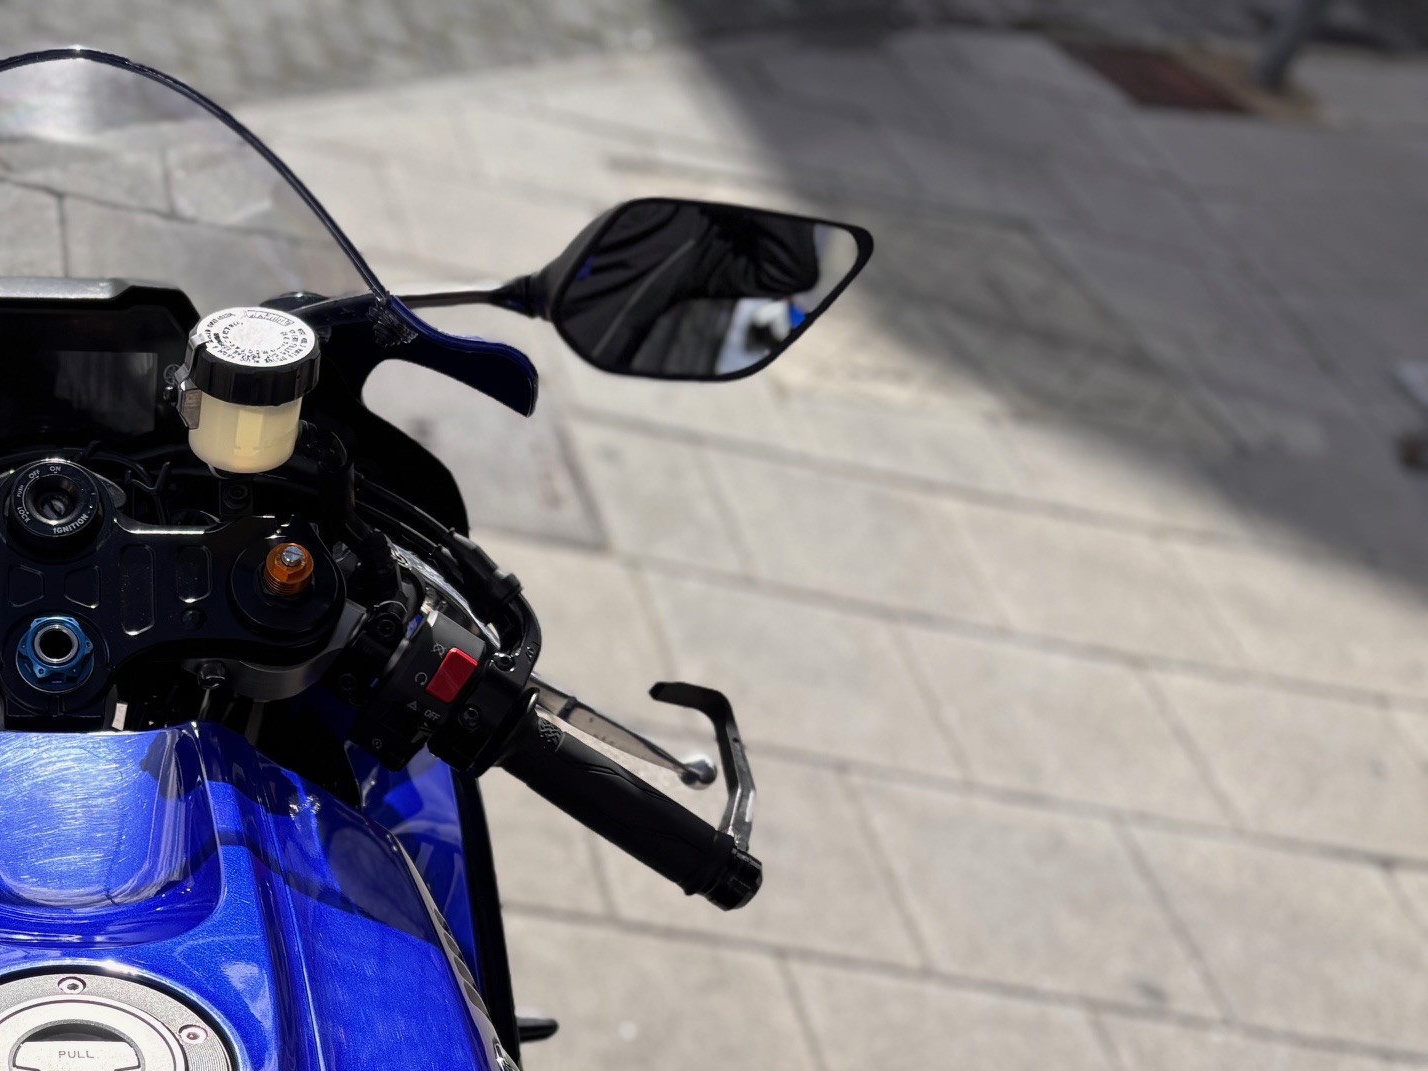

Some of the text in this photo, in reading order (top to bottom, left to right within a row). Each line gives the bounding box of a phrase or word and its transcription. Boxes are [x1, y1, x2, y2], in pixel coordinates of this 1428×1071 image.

[29, 469, 40, 479] OFF
[16, 484, 24, 498] PUSH
[17, 506, 31, 523] LOCK
[53, 513, 89, 534] IGNITION
[424, 709, 441, 720] OFF
[58, 1050, 94, 1059] PULL
